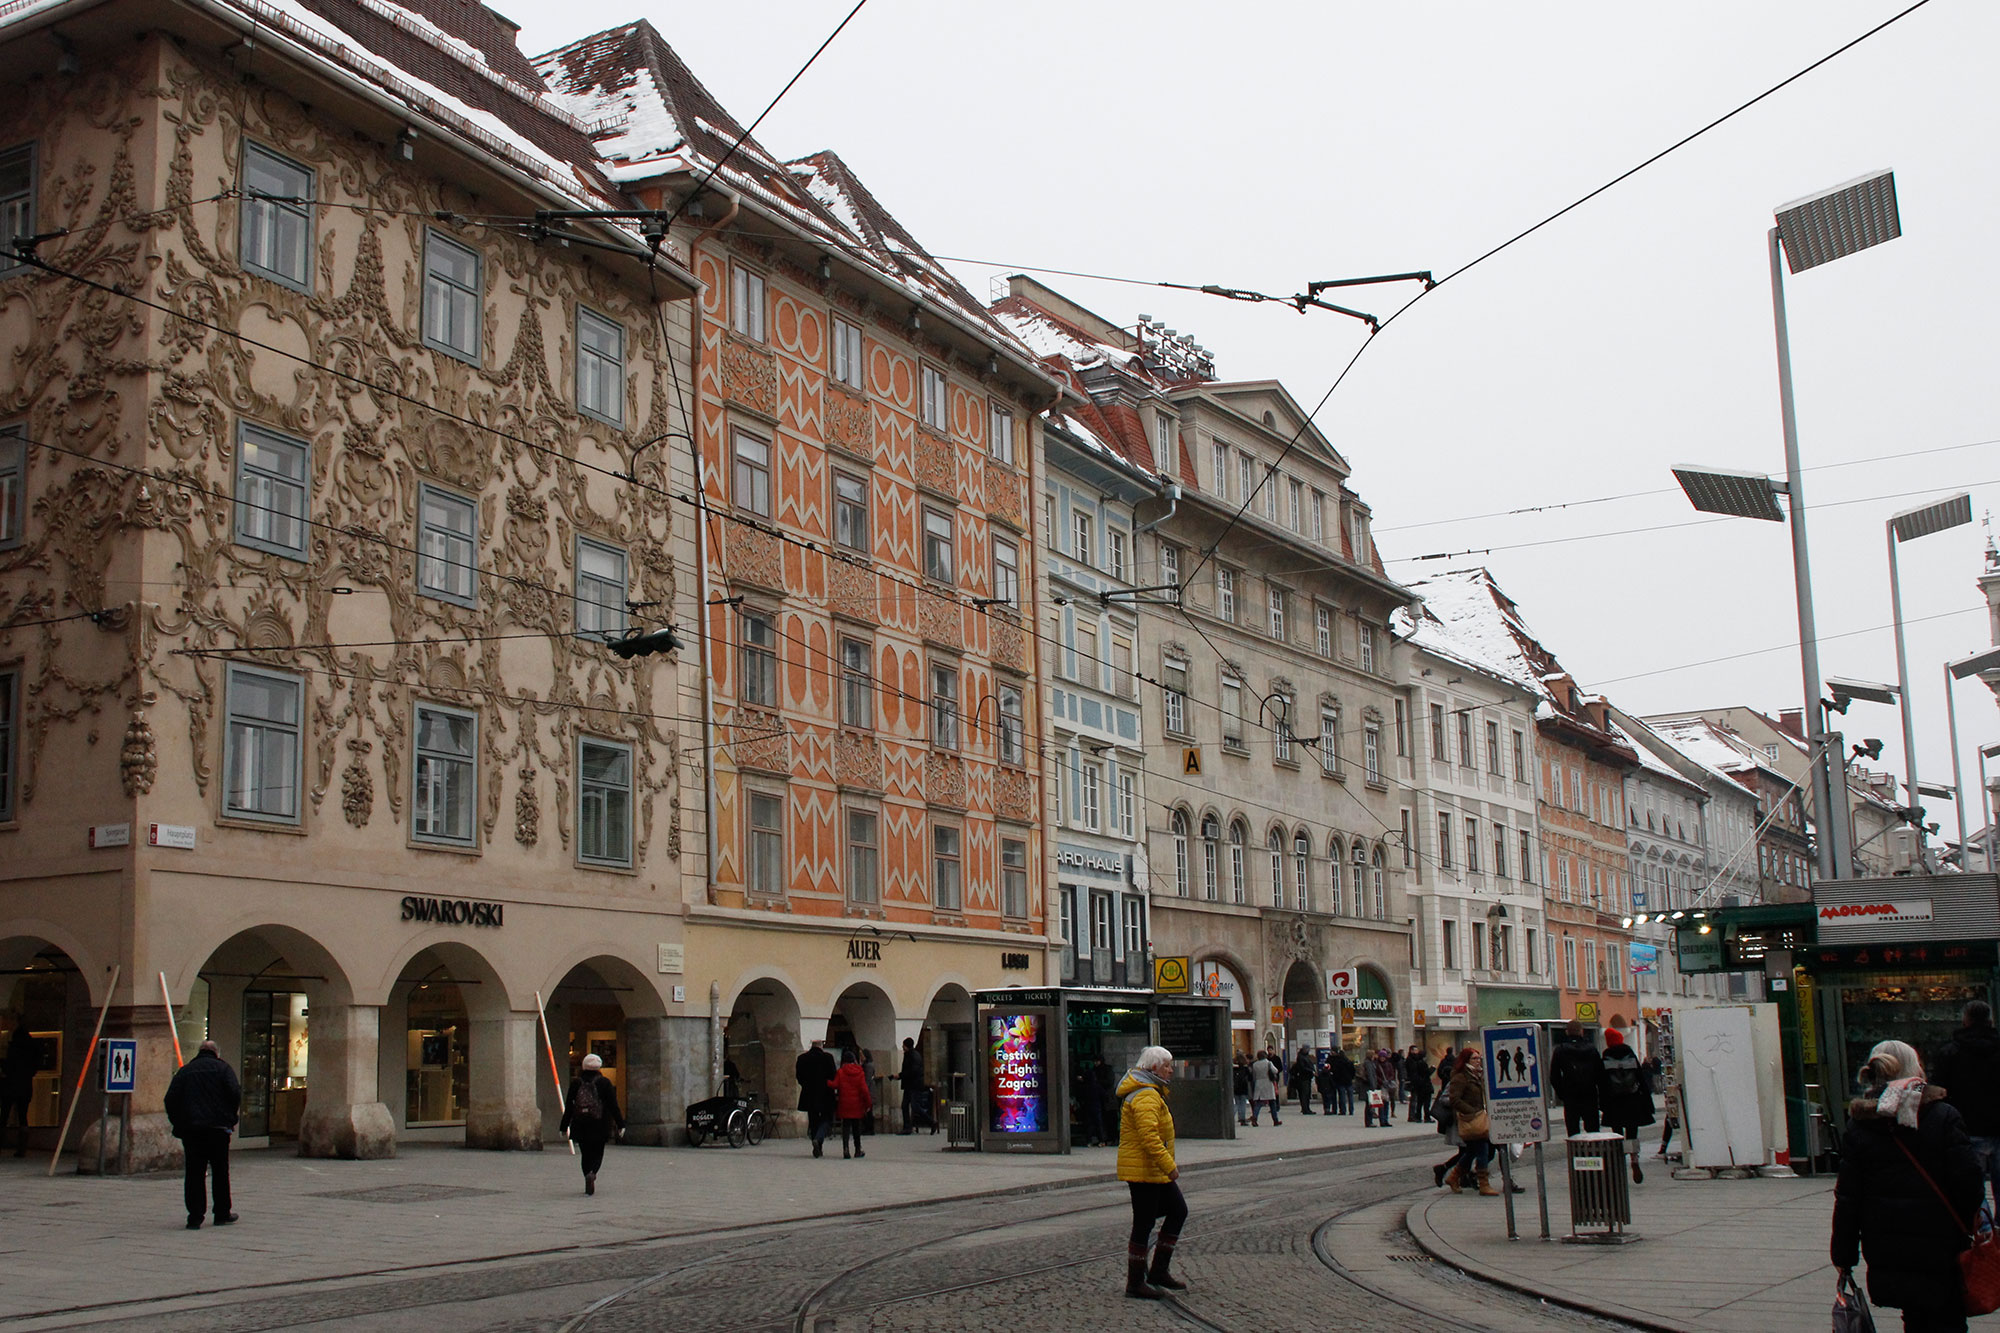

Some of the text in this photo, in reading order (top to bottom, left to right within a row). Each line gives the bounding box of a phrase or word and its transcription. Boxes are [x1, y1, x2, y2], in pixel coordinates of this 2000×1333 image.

[1186, 751, 1200, 772] A
[1634, 895, 1644, 905] W
[401, 896, 504, 927] SWAROVSKI
[1820, 904, 1898, 920] MORAWA
[847, 939, 881, 961] AUER
[1944, 947, 1969, 957] LIFT
[1329, 988, 1354, 996] ruefa
[986, 994, 1013, 1002] TICKETS
[1344, 998, 1388, 1010] THE BODY SHOP
[1508, 1008, 1535, 1017] PALMERS
[996, 1050, 1040, 1060] Festival
[993, 1063, 1043, 1077] of Lights
[998, 1077, 1039, 1092] Zagreb
[1491, 1113, 1522, 1121] Fahrzeugen
[1497, 1132, 1517, 1140] Zufahrt
